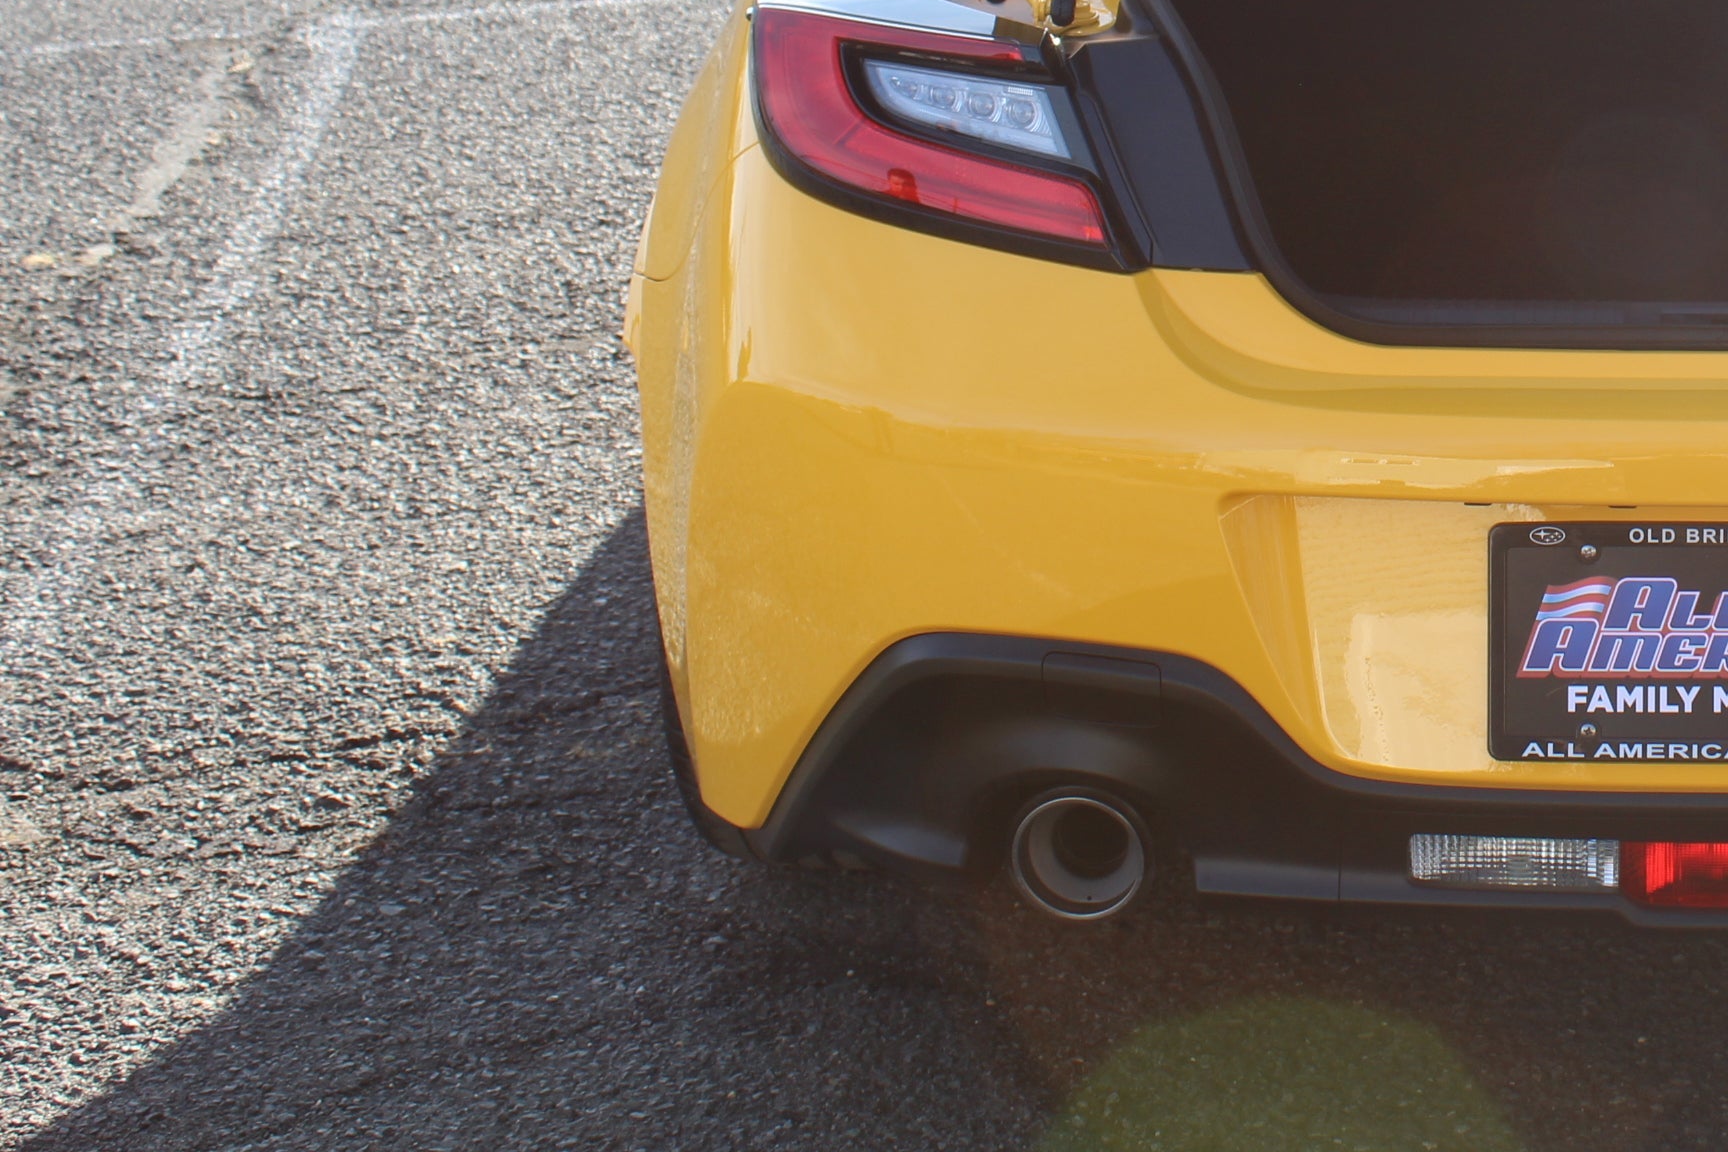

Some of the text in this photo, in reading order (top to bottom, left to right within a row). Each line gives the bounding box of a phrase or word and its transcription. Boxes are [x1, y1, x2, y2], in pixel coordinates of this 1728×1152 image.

[1629, 528, 1676, 544] OLD
[1567, 685, 1701, 714] FAMILY
[1521, 742, 1586, 759] ALL
